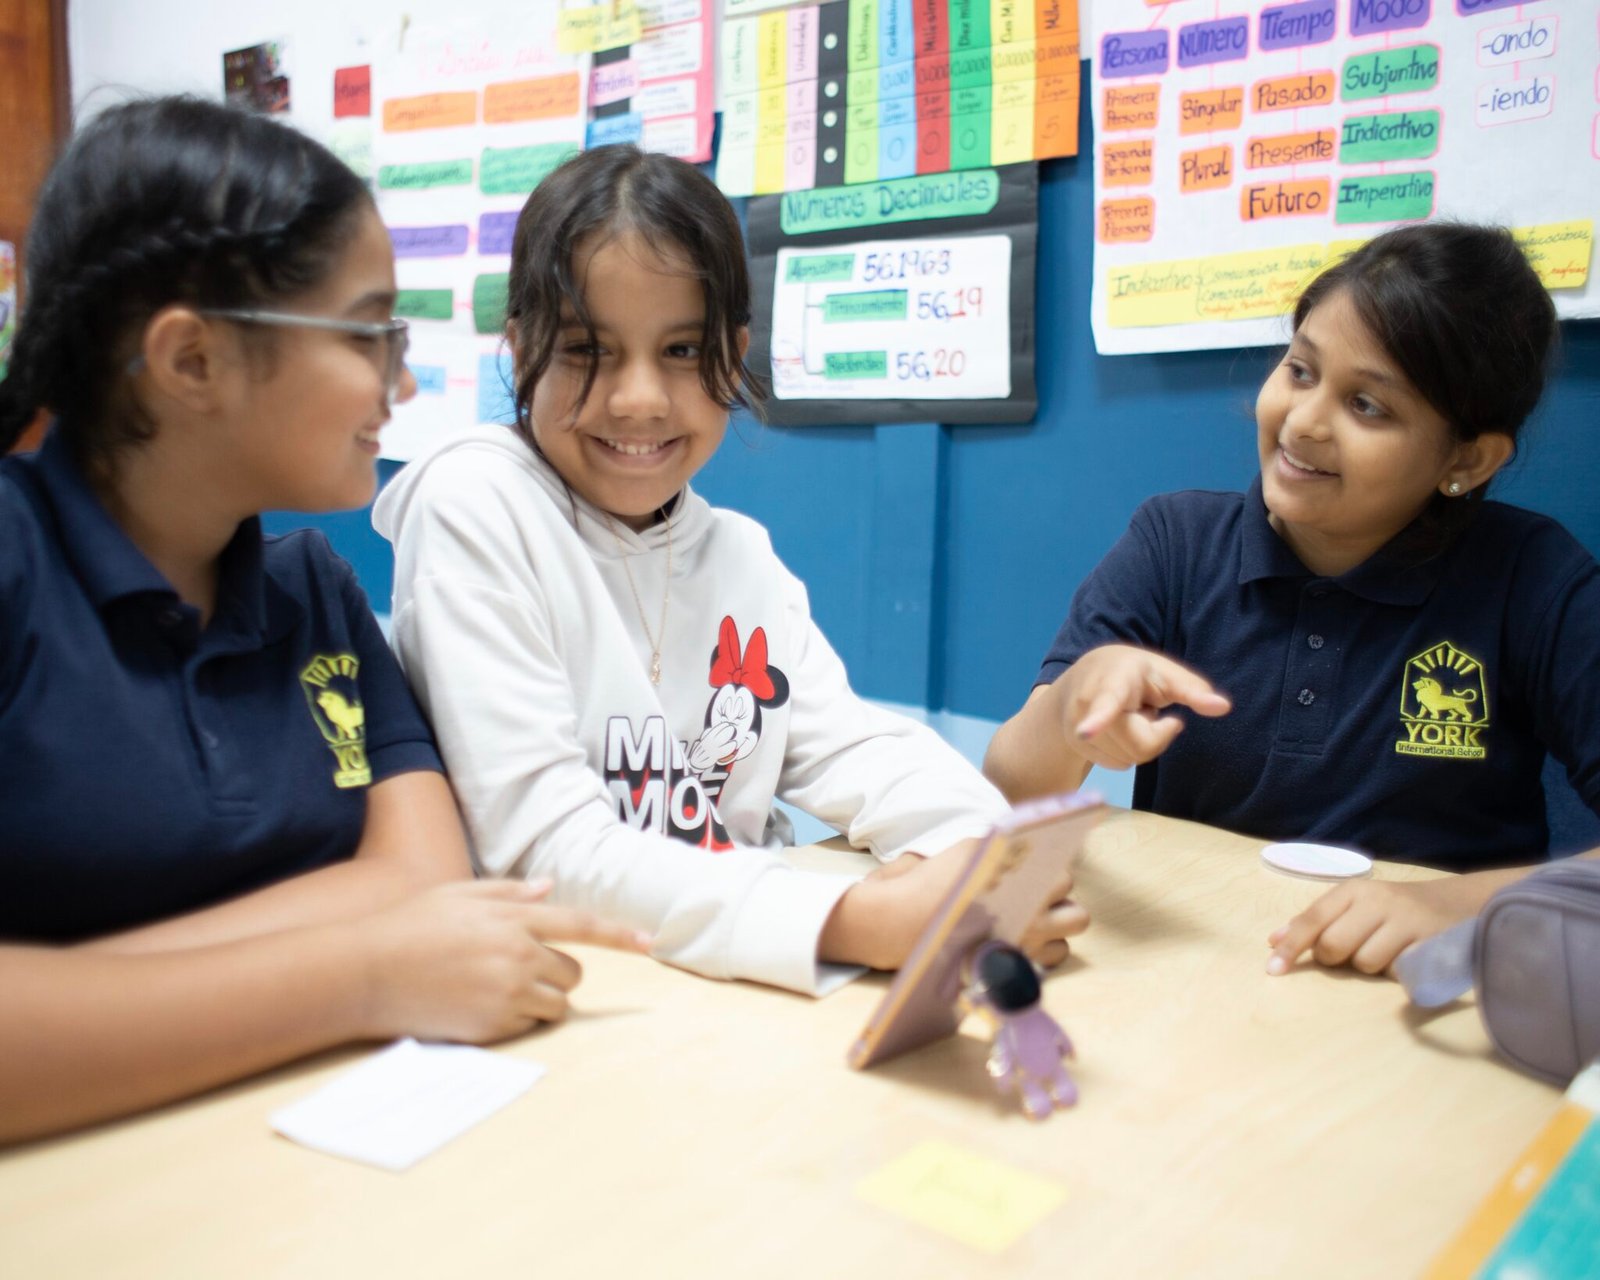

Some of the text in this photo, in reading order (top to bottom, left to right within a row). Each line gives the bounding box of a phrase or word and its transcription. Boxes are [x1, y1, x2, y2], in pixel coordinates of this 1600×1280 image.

[1261, 8, 1335, 42] Tiempo
[1103, 37, 1168, 70] Persona
[1344, 50, 1439, 92] Subjuntivo
[1182, 90, 1242, 125] Singular
[1258, 75, 1327, 110] Pasado
[1341, 113, 1435, 146] Indicativo
[1249, 131, 1333, 167] Presente
[1182, 150, 1230, 187] Plural
[876, 172, 991, 217] Decimales
[1248, 184, 1321, 219] Futuro
[1338, 174, 1433, 209] Imperativo
[1398, 744, 1484, 757] International School
[1405, 722, 1482, 748] YORK
